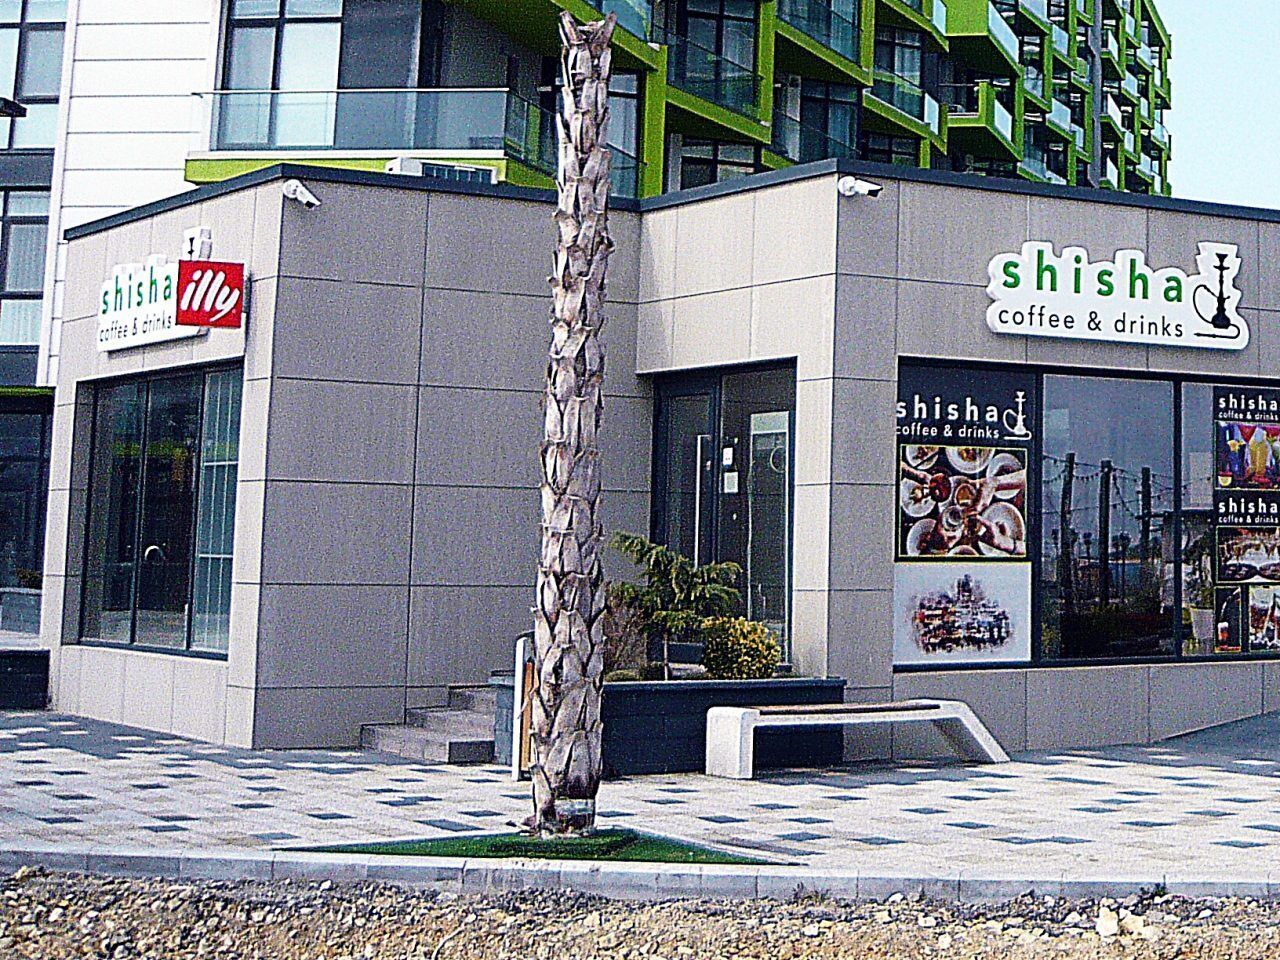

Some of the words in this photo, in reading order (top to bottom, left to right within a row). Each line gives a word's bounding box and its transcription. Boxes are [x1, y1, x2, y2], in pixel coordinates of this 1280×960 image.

[101, 265, 172, 315] shisha
[1002, 249, 1183, 303] shisha
[180, 269, 241, 323] illy
[99, 320, 128, 342] coffee
[131, 317, 138, 336] &
[142, 310, 172, 334] drinks
[998, 304, 1075, 329] coffee
[1087, 310, 1102, 332] &
[1114, 312, 1183, 338] drinks
[896, 394, 999, 422] shisha
[1218, 393, 1278, 411] shisha
[1218, 410, 1244, 419] coffee
[943, 424, 953, 437] &
[958, 424, 1000, 439] drinks
[1218, 497, 1278, 514] shisha
[1218, 514, 1244, 524] coffee
